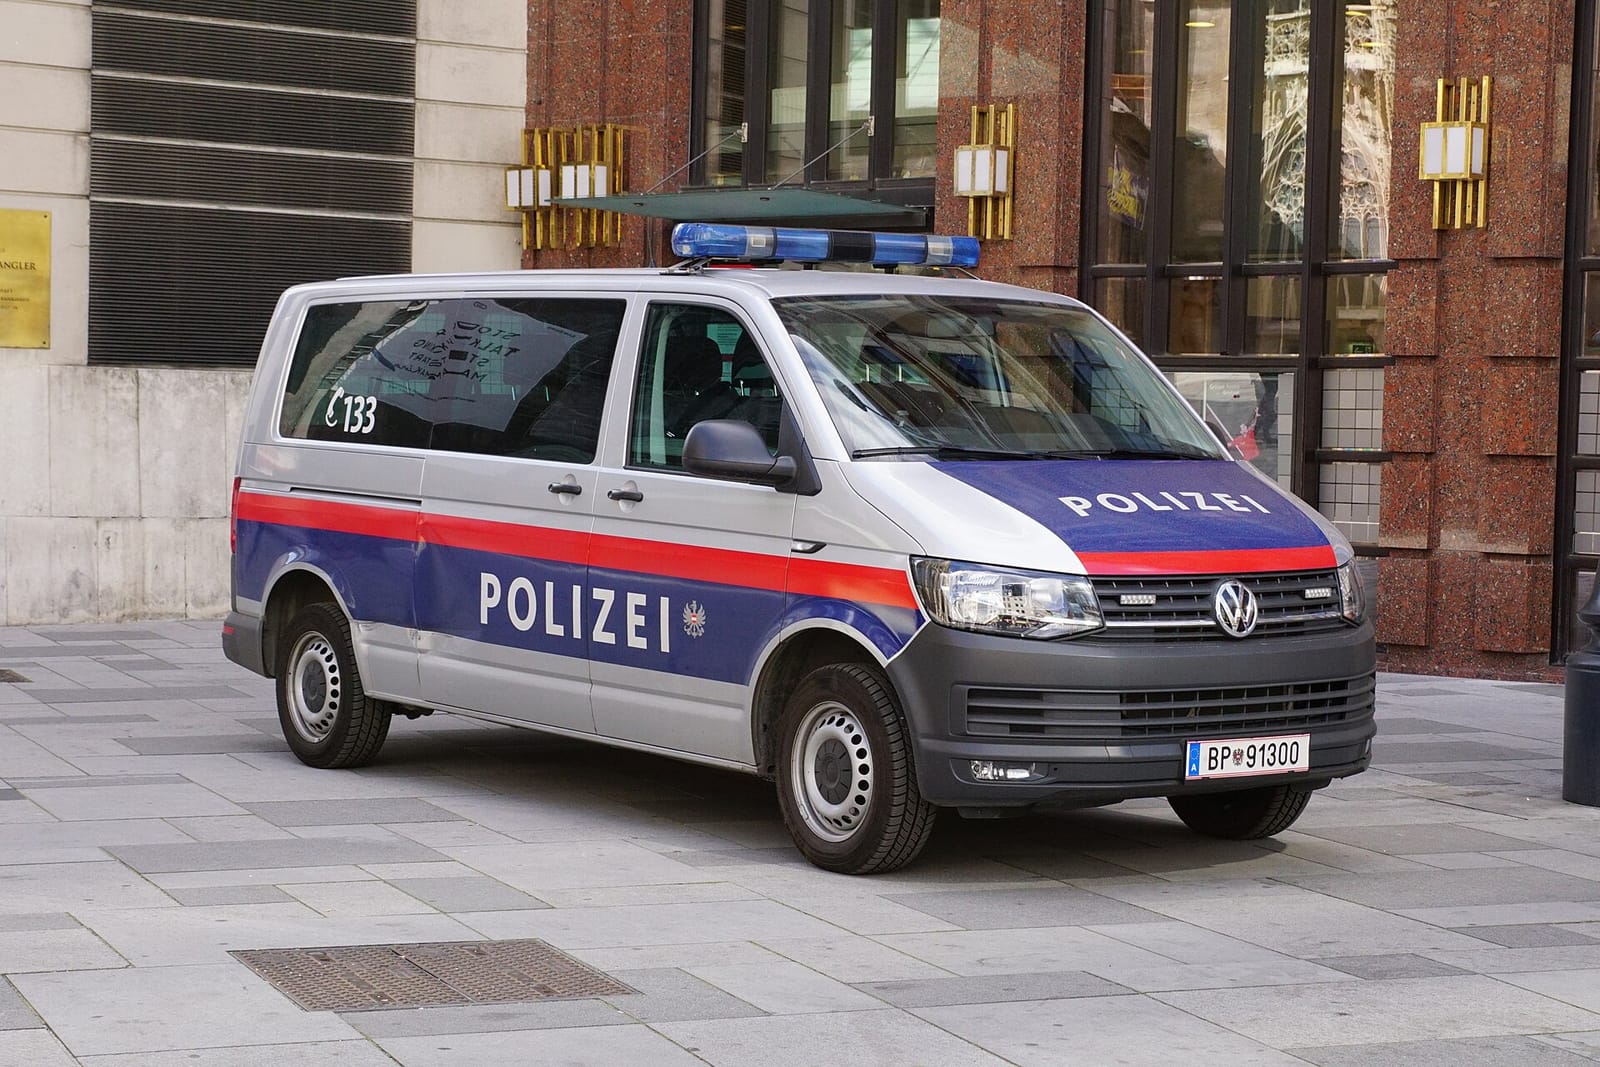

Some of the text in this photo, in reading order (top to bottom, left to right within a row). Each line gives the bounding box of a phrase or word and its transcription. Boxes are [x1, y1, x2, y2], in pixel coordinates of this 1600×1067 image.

[343, 395, 377, 434] 133
[1058, 491, 1272, 518] POLIZEI
[480, 571, 670, 653] POLIZEI
[1190, 763, 1197, 772] A
[1207, 740, 1300, 771] BP 91300
